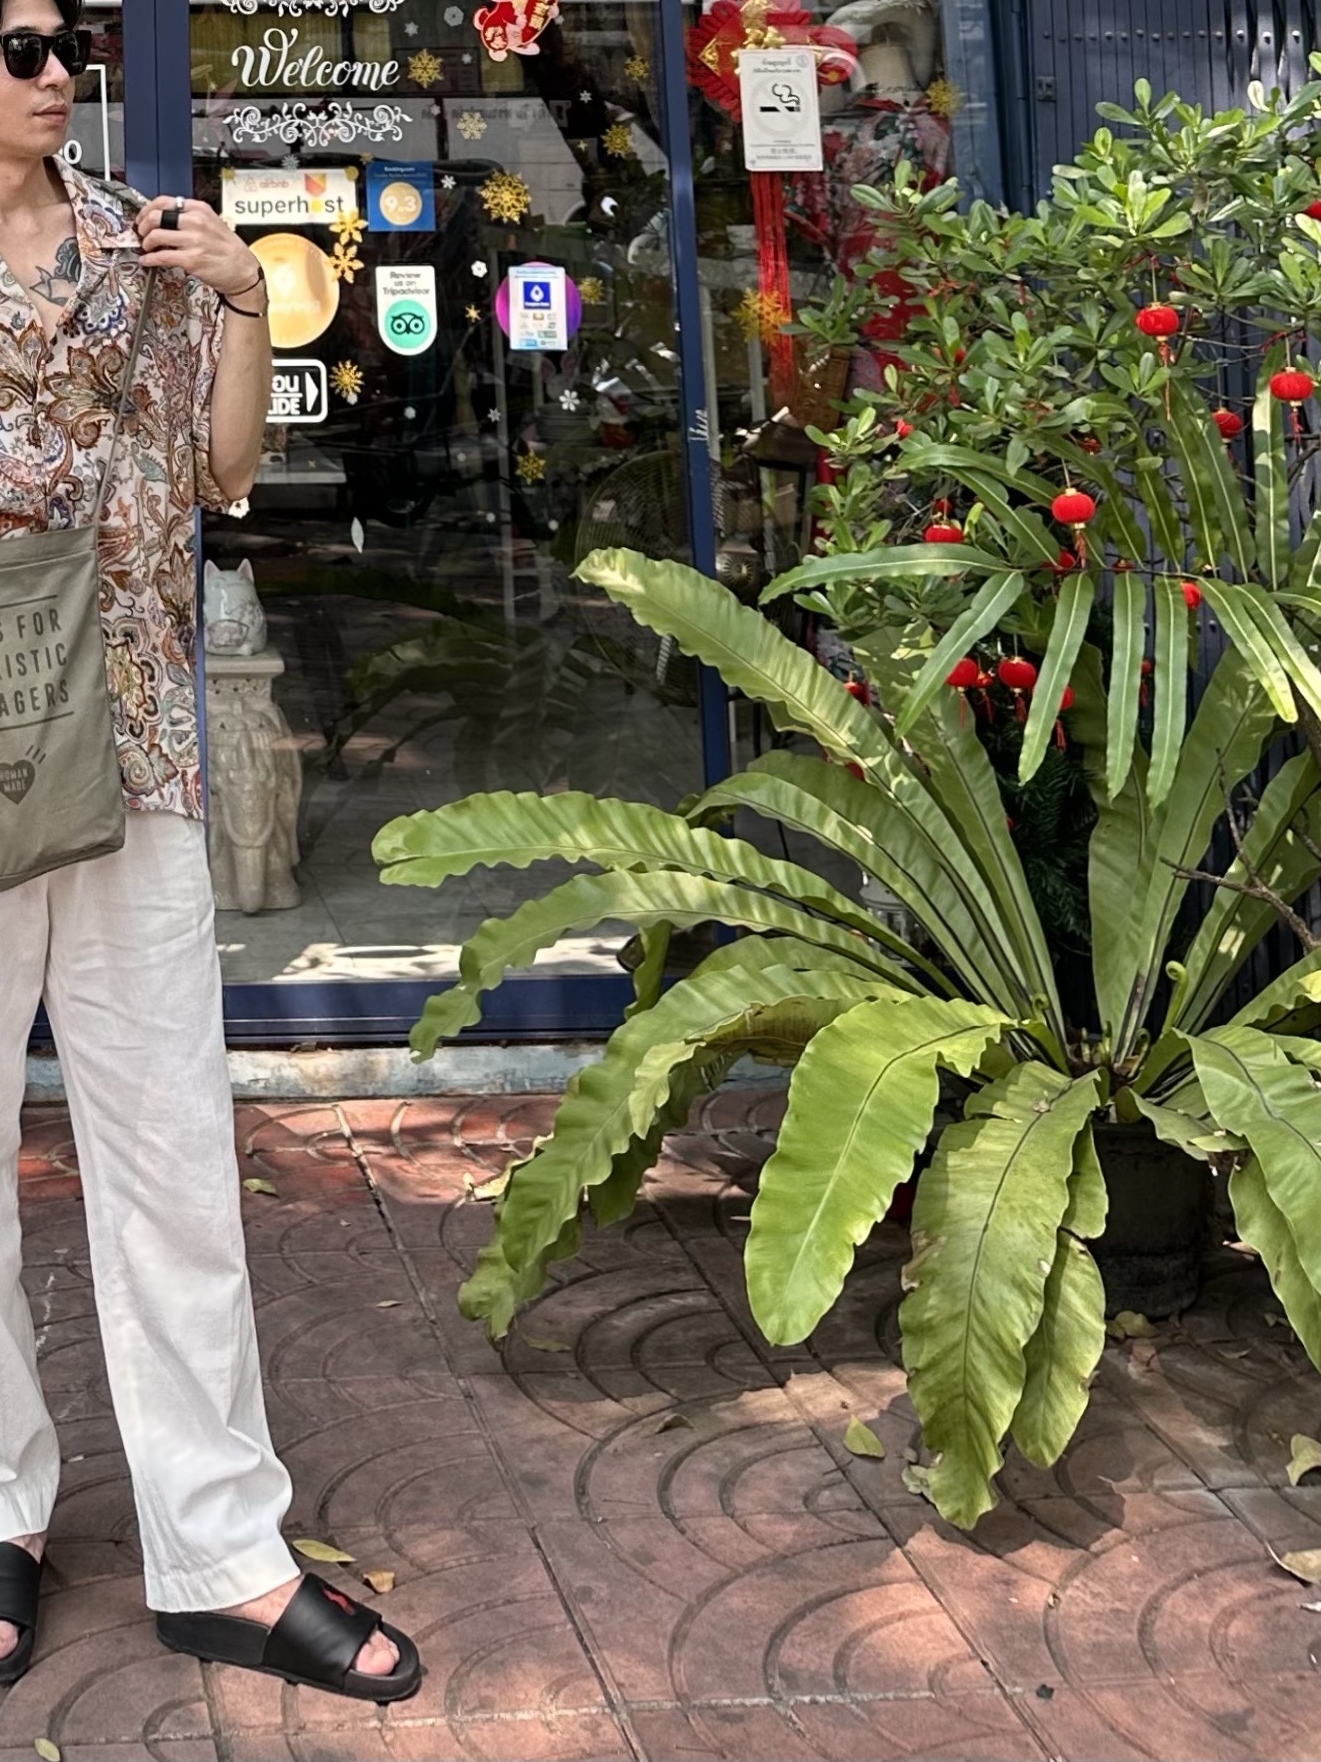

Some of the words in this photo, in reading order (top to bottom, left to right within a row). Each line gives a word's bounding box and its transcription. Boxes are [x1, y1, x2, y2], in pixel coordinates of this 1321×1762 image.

[231, 27, 401, 91] Welcome
[259, 178, 290, 189] airbnb
[235, 195, 345, 218] superhst
[384, 195, 418, 214] 9.3
[389, 271, 421, 279] Review
[382, 286, 431, 296] Tripadvisor
[267, 397, 301, 415] IDE
[16, 607, 62, 638] FOR
